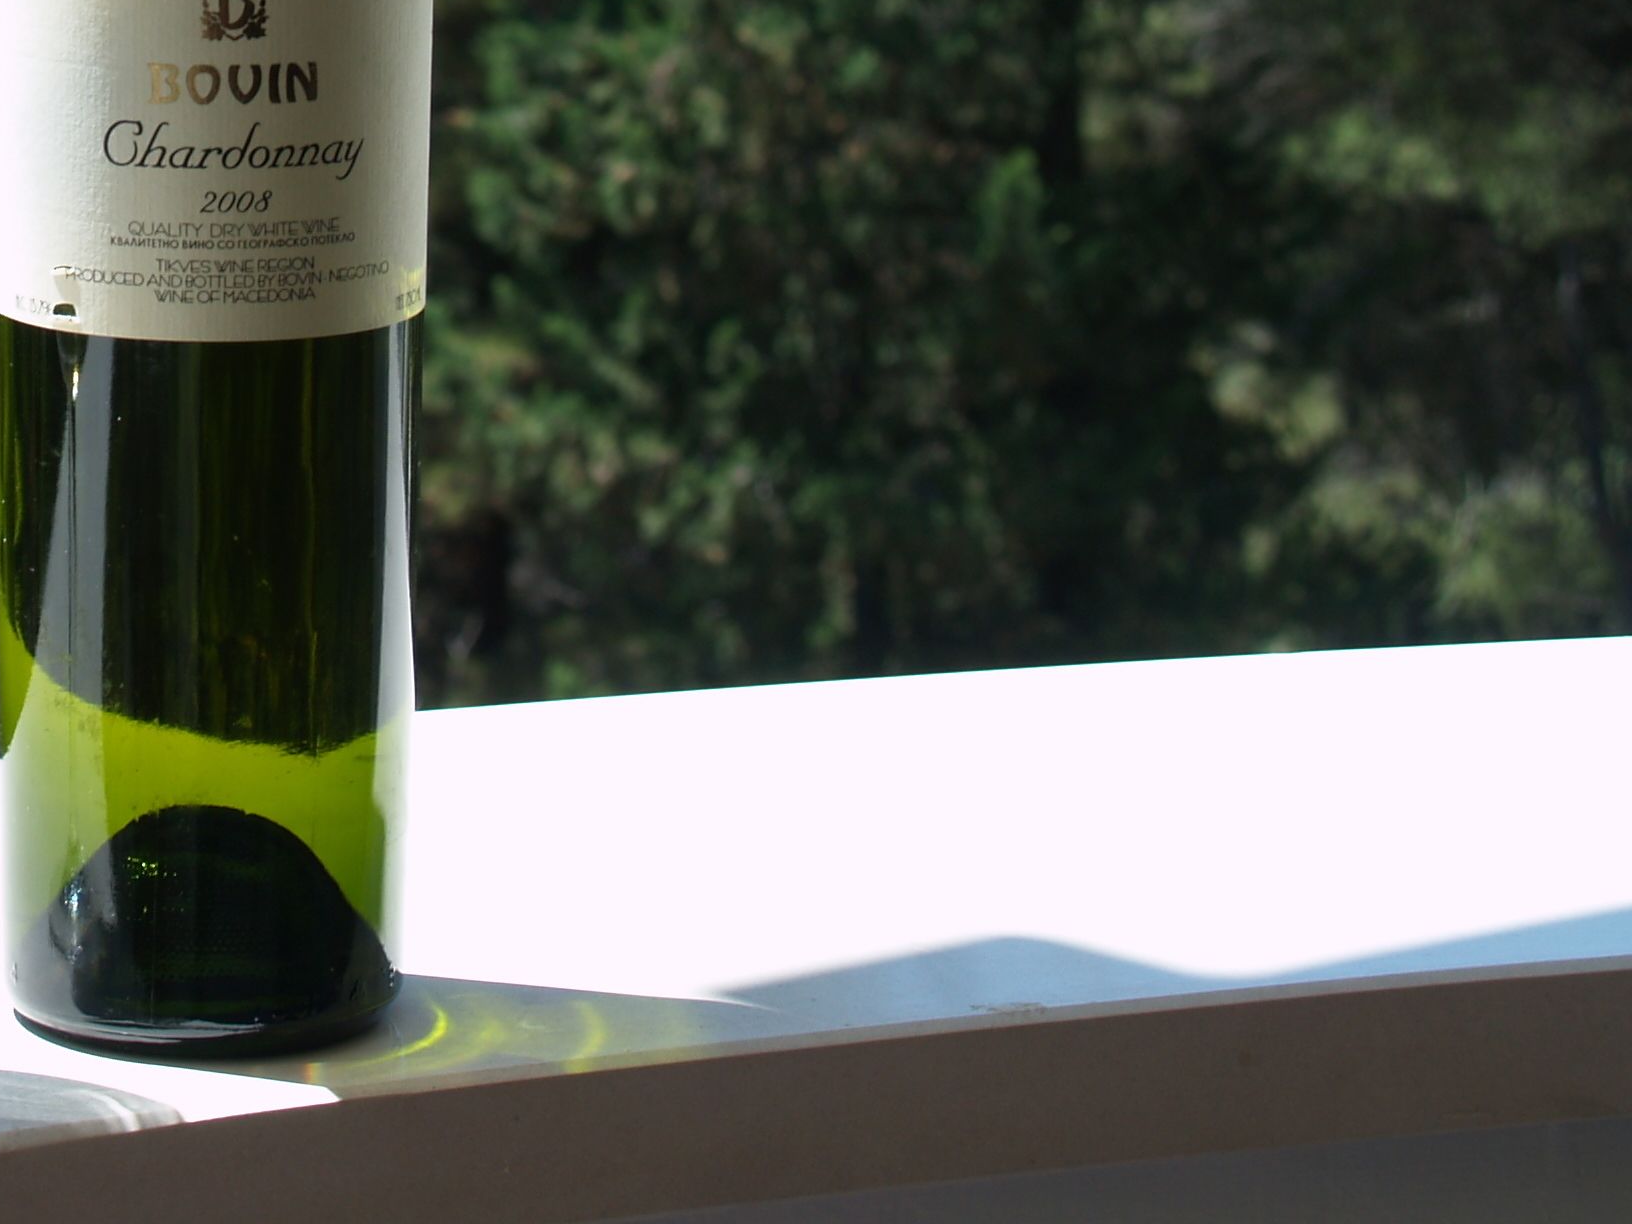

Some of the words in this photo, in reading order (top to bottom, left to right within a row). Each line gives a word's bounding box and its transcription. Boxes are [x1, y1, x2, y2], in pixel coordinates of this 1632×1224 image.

[146, 60, 319, 105] BOVIN
[102, 119, 365, 181] Chardonnay
[199, 190, 273, 214] 2008
[128, 220, 204, 237] QUALITY
[210, 223, 245, 238] DRY
[246, 220, 299, 237] WHITE
[300, 216, 341, 233] WINE
[110, 236, 180, 250] КВАЛИТЕТНО
[182, 239, 215, 250] ВИНО
[156, 258, 212, 274] TIKVES
[213, 259, 255, 273] WINE
[257, 255, 316, 273] REGION
[65, 267, 145, 287] PRODUCED
[146, 273, 183, 288] AND
[185, 274, 256, 289] BOTTLED
[257, 274, 277, 289] BY
[154, 289, 194, 303] WINE
[196, 289, 221, 304] OF
[223, 287, 317, 304] MACEDONIA
